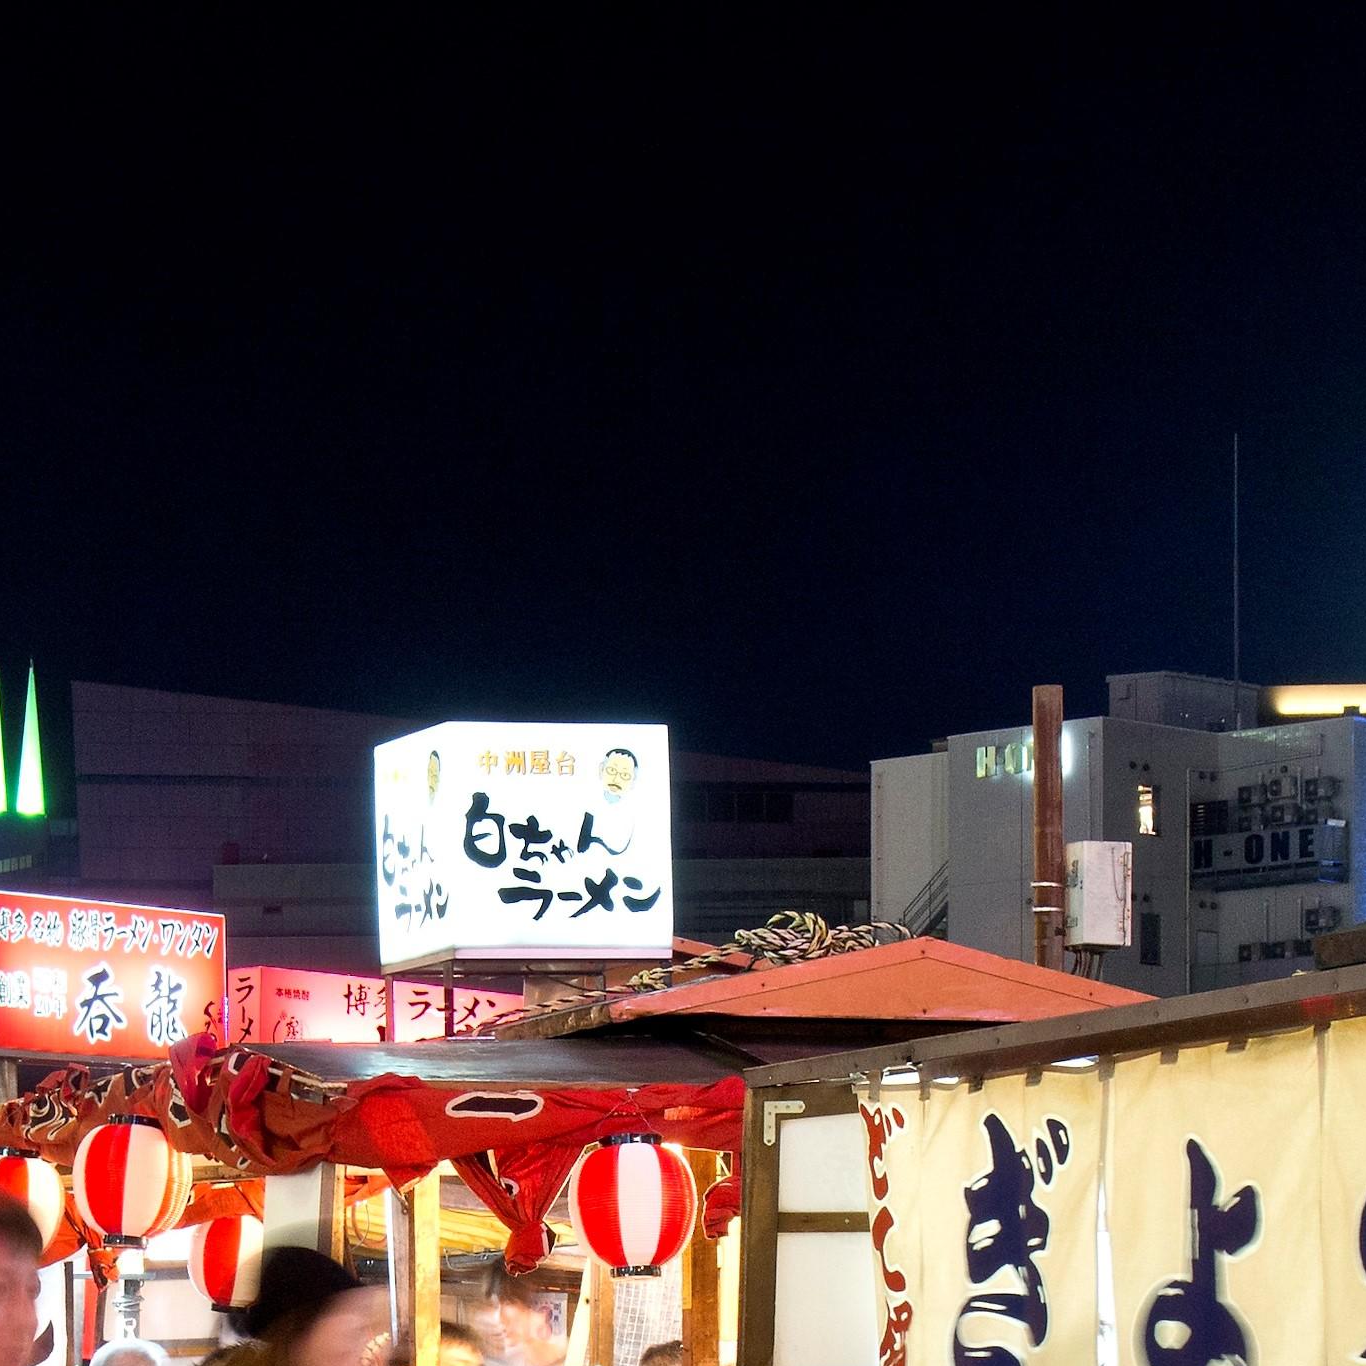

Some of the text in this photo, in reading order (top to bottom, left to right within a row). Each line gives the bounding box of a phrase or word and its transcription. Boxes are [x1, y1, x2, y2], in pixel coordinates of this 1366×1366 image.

[478, 750, 577, 776] 中洲屋台
[464, 791, 635, 868] 白ちゃん
[1193, 828, 1315, 870] H-ONE
[395, 878, 449, 932] ラーメン
[498, 868, 661, 921] ラーメン
